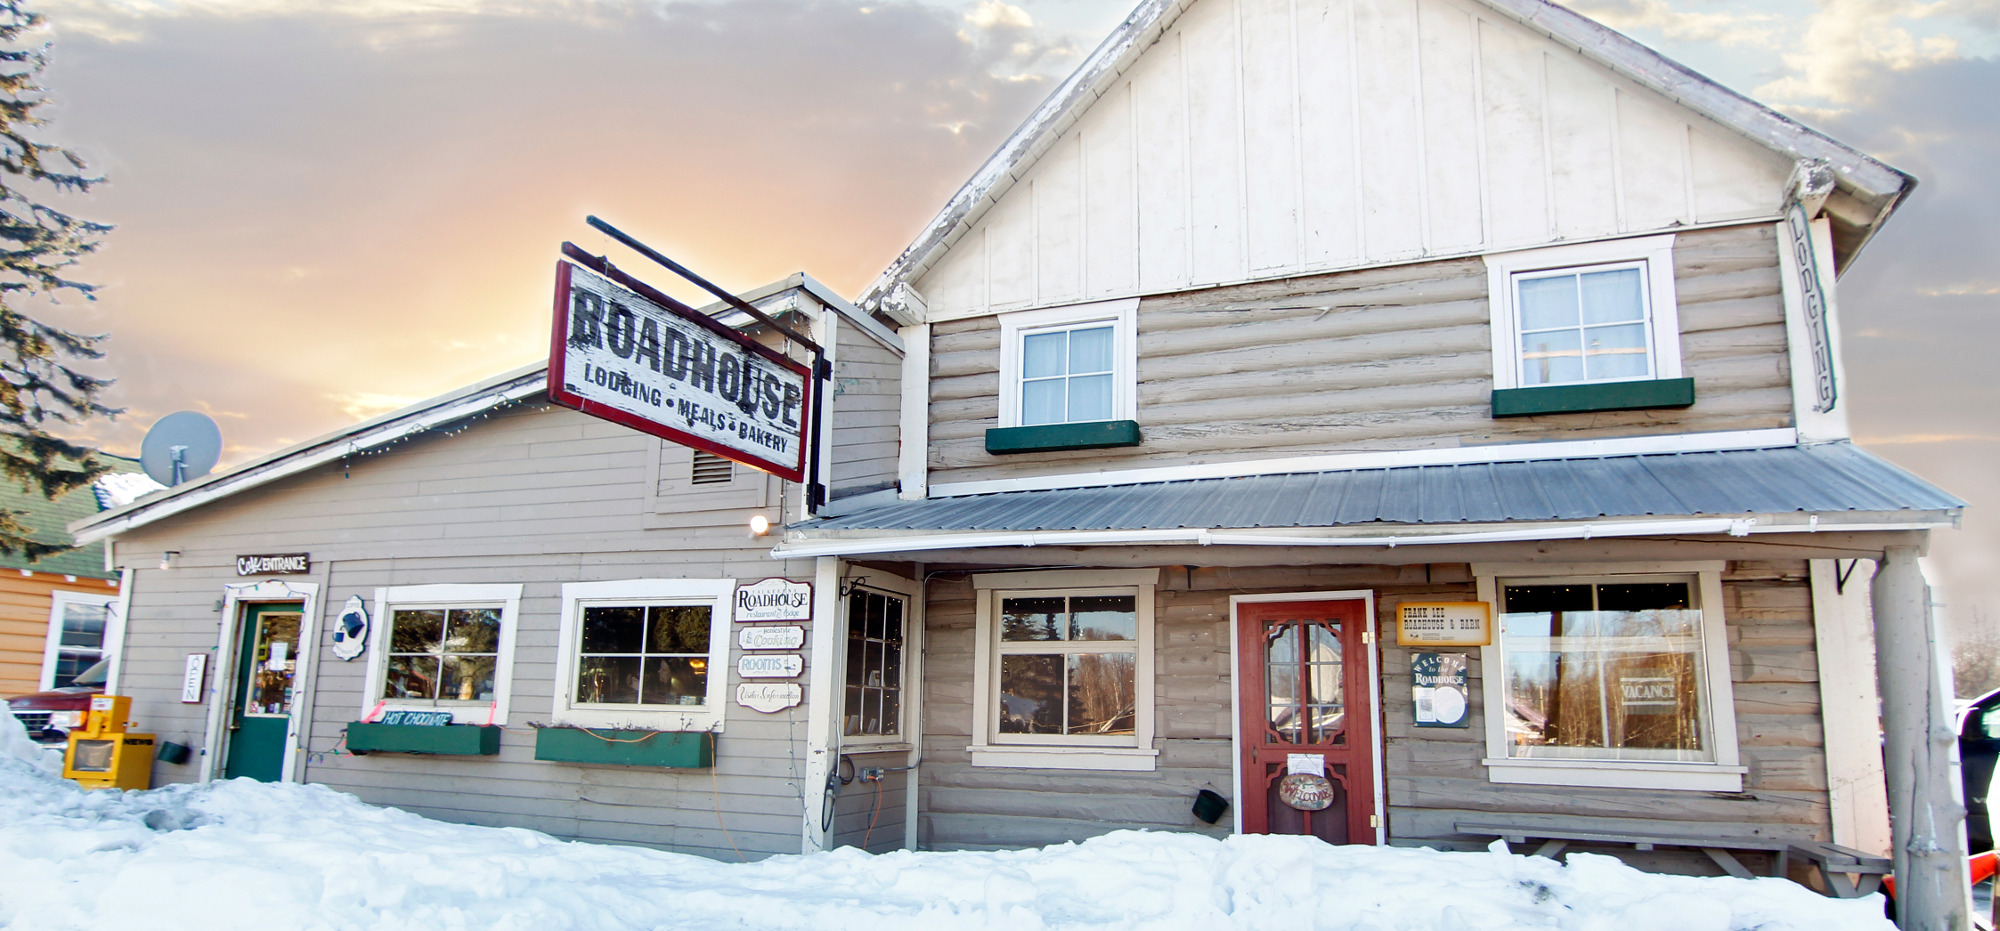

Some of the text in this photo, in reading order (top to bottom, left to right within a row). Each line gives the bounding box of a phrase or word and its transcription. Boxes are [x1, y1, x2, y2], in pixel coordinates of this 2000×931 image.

[1791, 216, 1830, 401] LODGING
[571, 285, 801, 428] ROADHOUSE
[584, 363, 788, 453] LODGING MEALS BAKERY
[263, 556, 307, 571] ENTRANCE
[738, 590, 808, 611] ROADHOUSE
[1404, 607, 1428, 618] FRANK
[1404, 619, 1445, 630] ROADHOUSE
[1460, 619, 1480, 630] BARN
[1413, 656, 1466, 673] WELCOME
[1438, 665, 1449, 673] the
[186, 656, 200, 700] OPEN
[1414, 673, 1463, 685] ROADHOUSE
[1621, 684, 1676, 698] VACANCY
[382, 712, 405, 725] HOT
[1284, 785, 1332, 802] WELCOME
